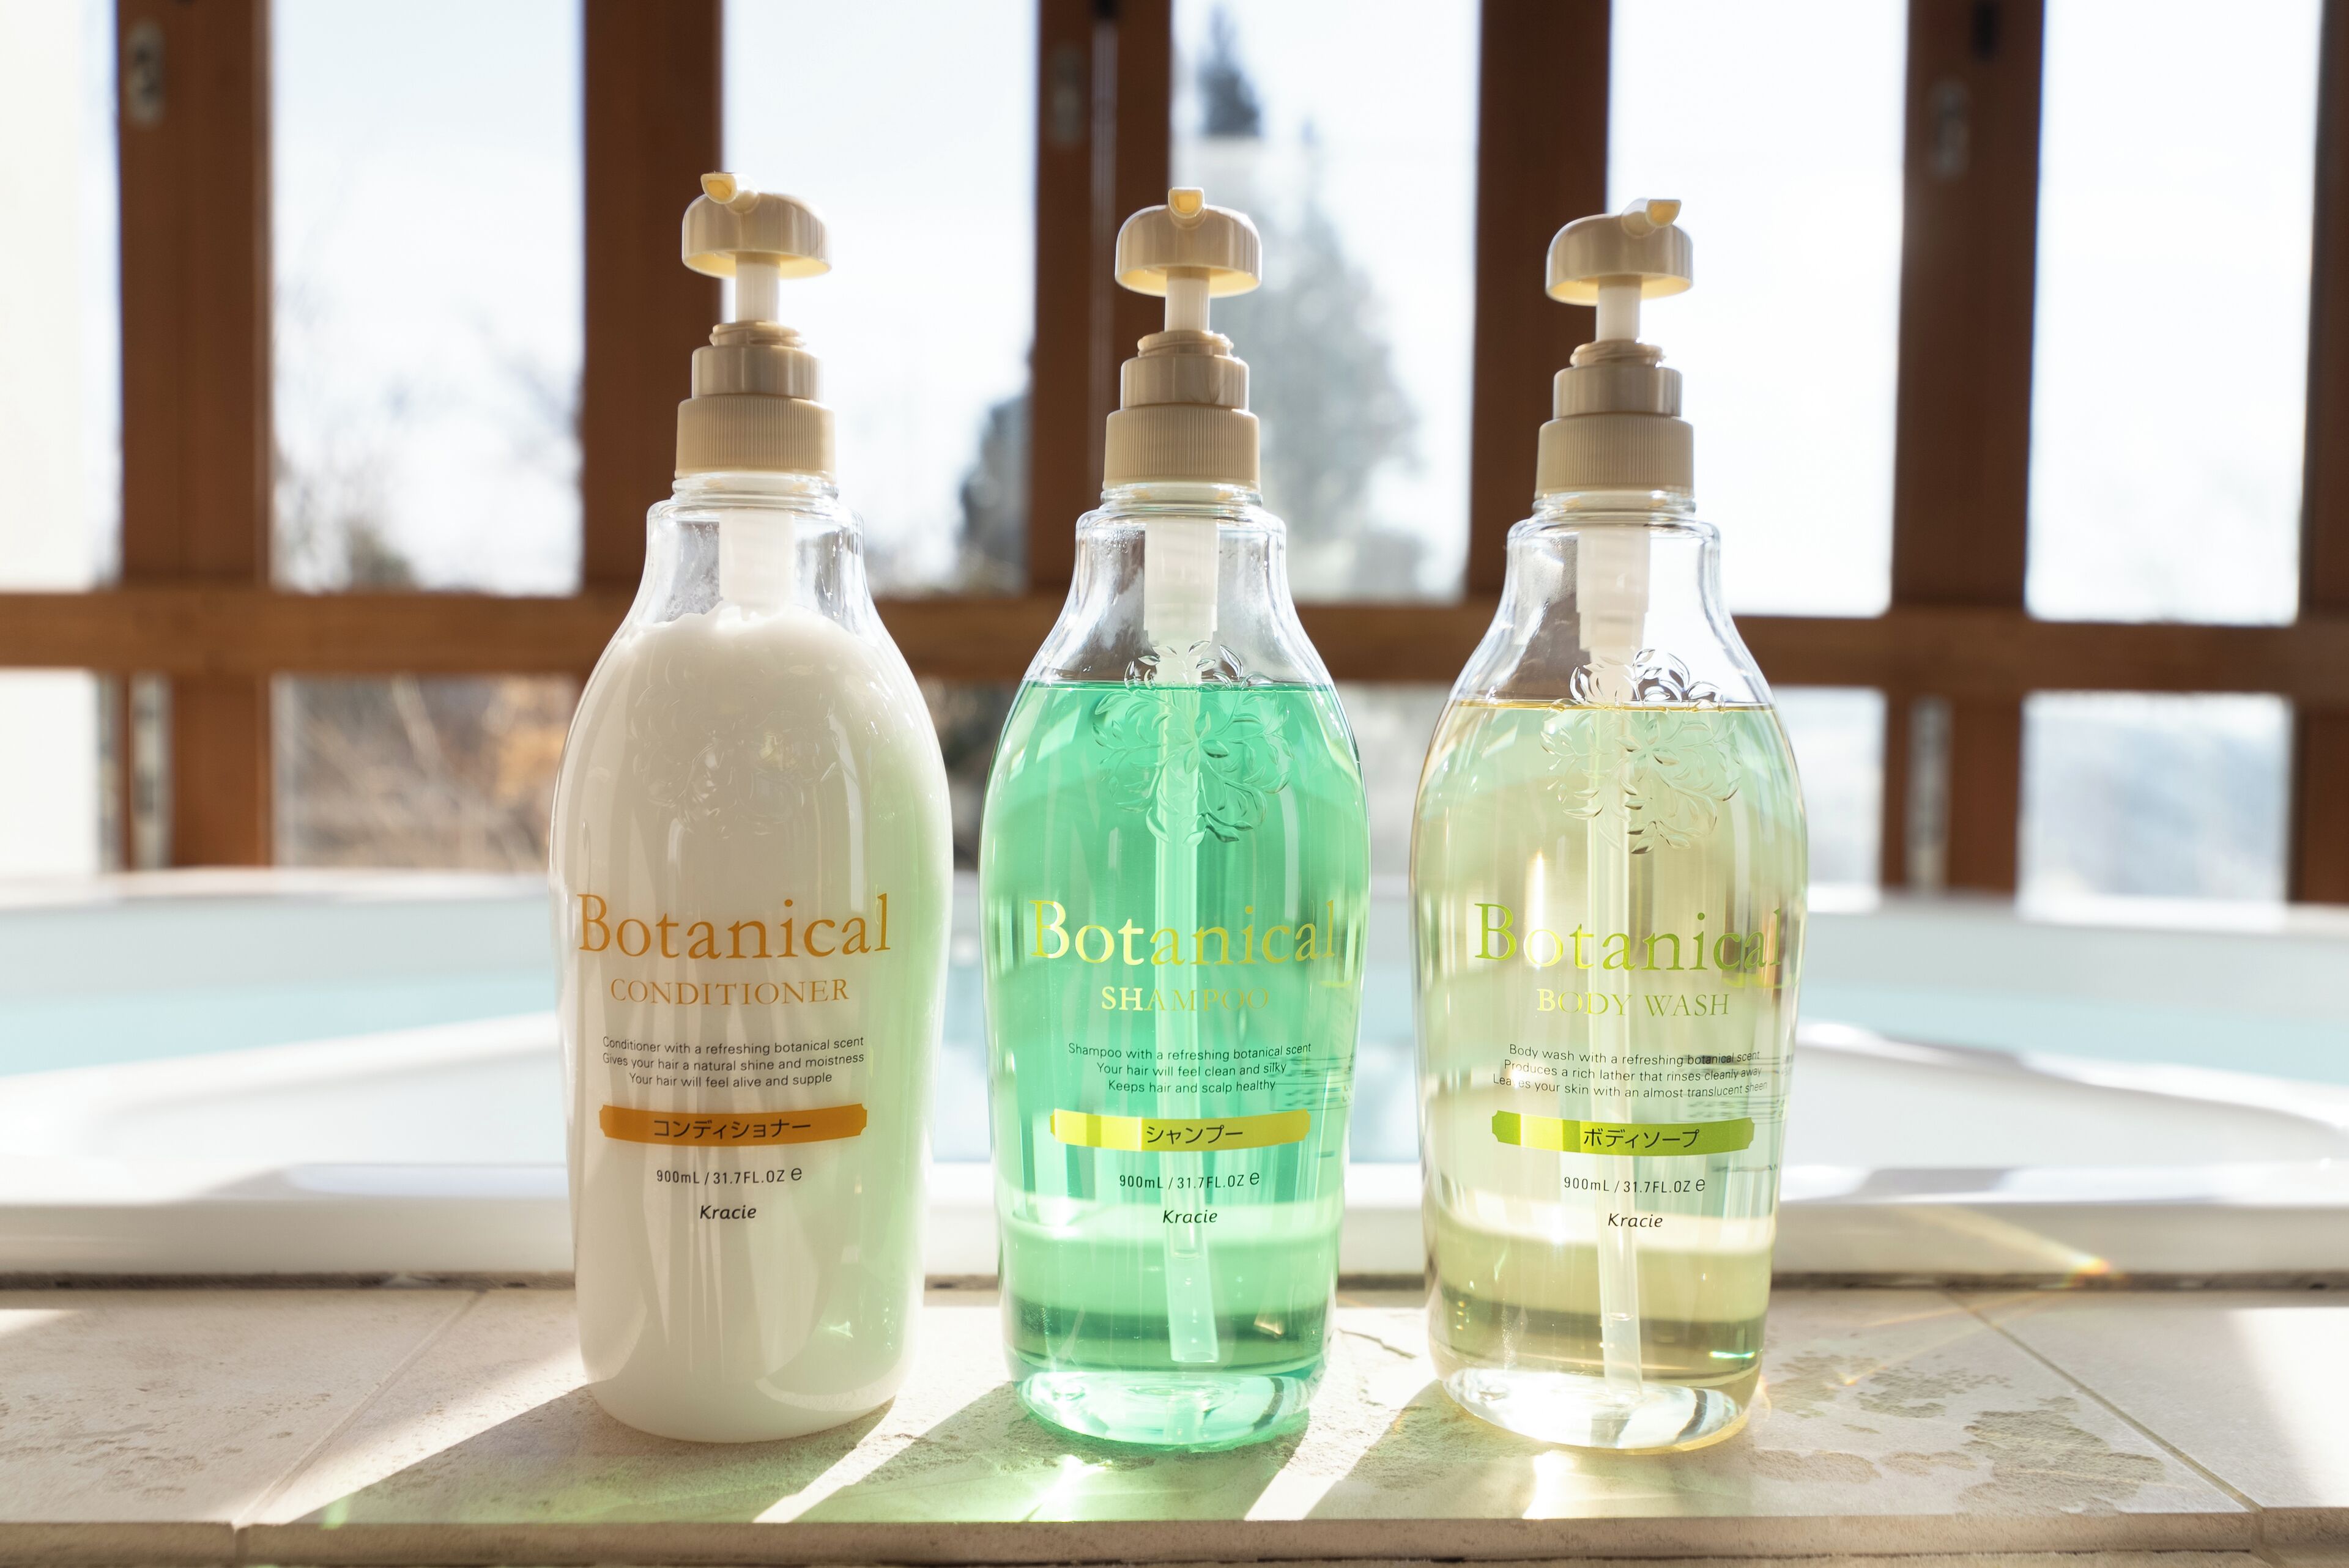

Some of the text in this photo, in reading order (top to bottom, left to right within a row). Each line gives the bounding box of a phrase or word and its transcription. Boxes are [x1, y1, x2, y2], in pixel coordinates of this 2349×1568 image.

[577, 892, 891, 960] Botanical
[1029, 900, 1335, 966] Botanical
[1474, 903, 1781, 971] Botanical
[611, 978, 849, 1005] CONDITIONER
[1101, 986, 1269, 1011] SHAMPOO
[1537, 988, 1730, 1017] BODY WASH
[603, 1036, 864, 1056] Conditioner with a refreshing botanical scent
[1068, 1043, 1312, 1062] Shampoo with a refreshing botanical scent
[1509, 1043, 1760, 1067] Body wash with a refreshing botanical scent
[603, 1052, 864, 1071] Gives your hair a natural shine and moistness
[1097, 1062, 1286, 1077] Your hair will feel clean and silky
[1504, 1059, 1557, 1076] Produces
[1561, 1068, 1568, 1077] a
[1573, 1068, 1595, 1079] rich
[1600, 1069, 1635, 1081] lather
[1640, 1071, 1662, 1082] that
[1667, 1071, 1701, 1082] rinses
[1704, 1068, 1739, 1081] cleanly
[1740, 1066, 1762, 1078] away
[629, 1072, 832, 1087] Your hair will feel alive and supple
[1108, 1079, 1276, 1095] Keeps hair and scalp healthy
[1493, 1073, 1767, 1098] Leaes your skin with an almost translucent sheen
[653, 1118, 811, 1140] コンディショナー
[1146, 1124, 1244, 1145] シャンプー
[1583, 1128, 1700, 1150] ボディソープ
[656, 1169, 700, 1185] 900mL
[704, 1170, 710, 1185] /
[713, 1169, 785, 1185] 31.7FL.OZ
[1119, 1174, 1163, 1189] 900mL
[1168, 1176, 1173, 1190] /
[1177, 1174, 1244, 1189] 31.7FL.OZ
[1564, 1176, 1610, 1193] 900mL
[1614, 1178, 1620, 1193] /
[1623, 1178, 1691, 1194] 31.7FL.OZ
[699, 1205, 757, 1221] Kracie
[1162, 1210, 1218, 1224] Kracie
[1607, 1213, 1663, 1228] Kracie
